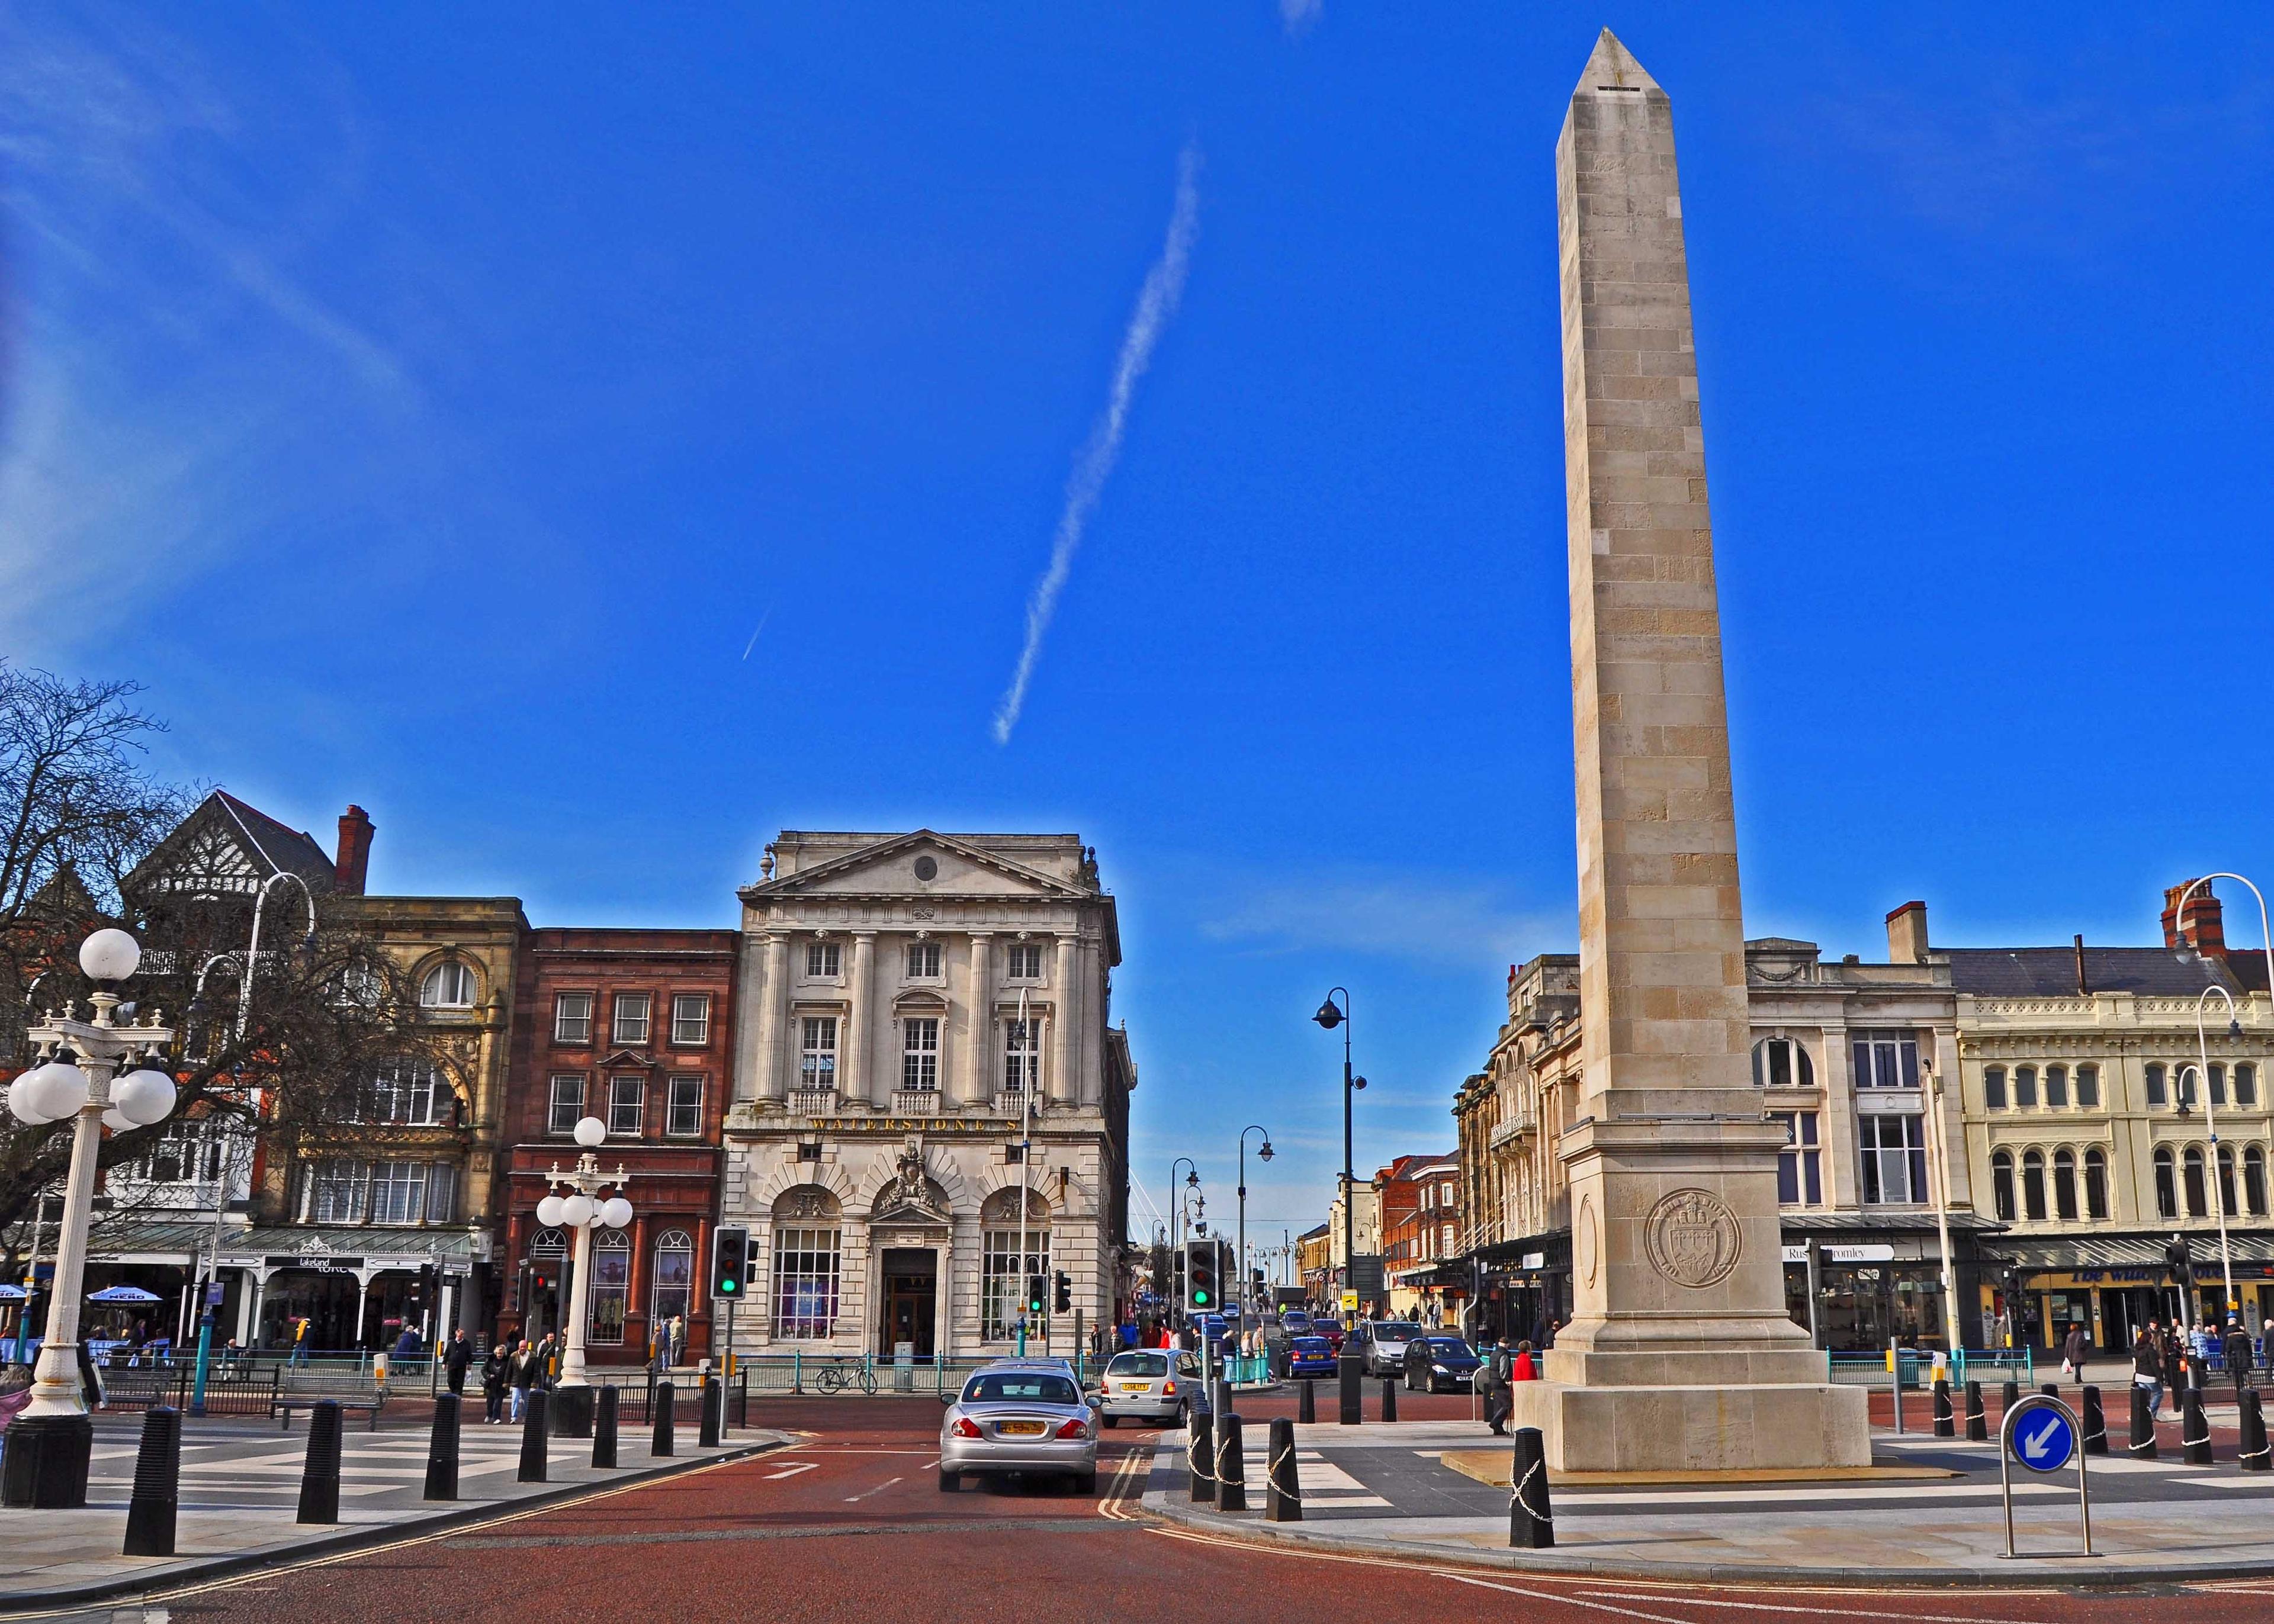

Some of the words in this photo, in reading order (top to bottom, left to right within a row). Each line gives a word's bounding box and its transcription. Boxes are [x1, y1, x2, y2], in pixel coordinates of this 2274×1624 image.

[812, 1118, 1017, 1130] WATERSTONE'S
[1829, 1248, 1865, 1259] romley
[300, 1258, 330, 1267] lakeland
[2071, 1269, 2103, 1282] The
